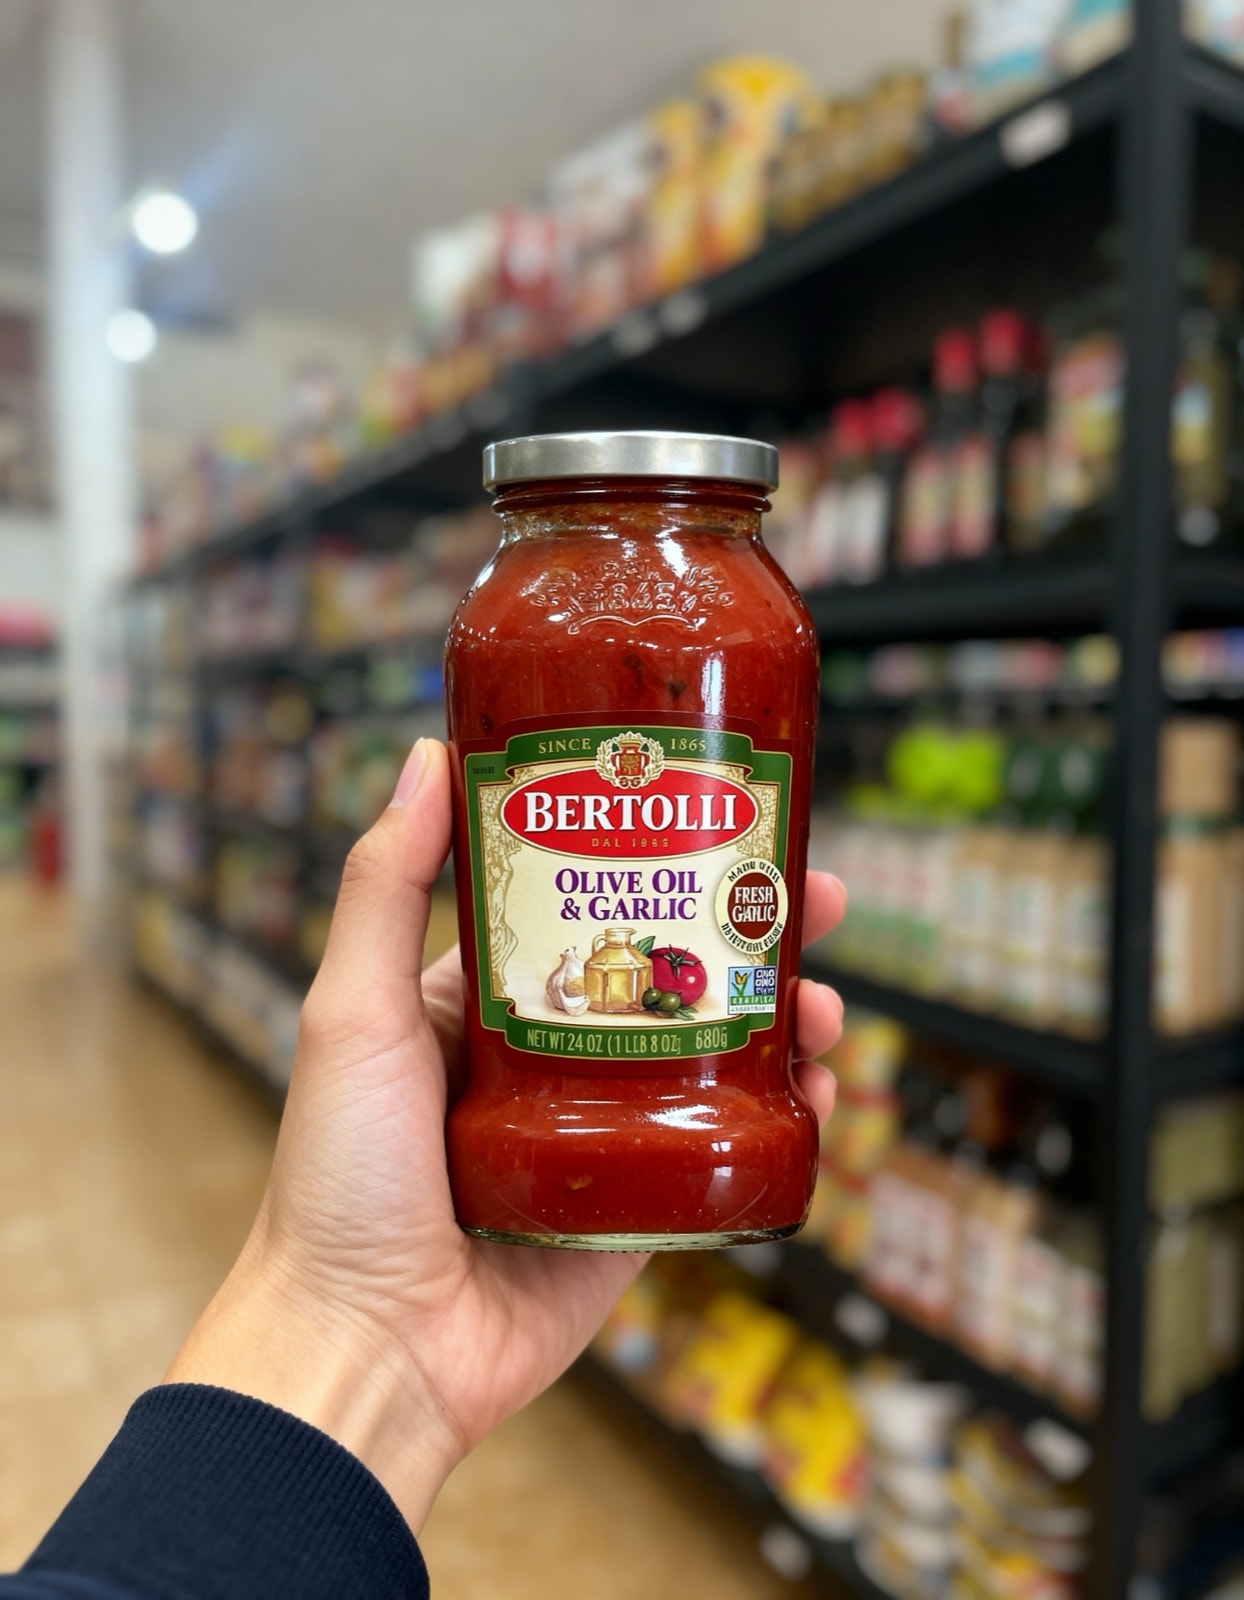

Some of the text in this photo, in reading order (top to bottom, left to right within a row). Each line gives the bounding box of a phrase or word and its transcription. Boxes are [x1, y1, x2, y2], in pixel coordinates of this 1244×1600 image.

[538, 737, 706, 754] SINCE 1865
[523, 791, 737, 833] BERTOLLI
[591, 837, 621, 848] DAL
[555, 868, 702, 894] OLIVE OIL
[734, 886, 774, 904] FRESH
[560, 896, 697, 921] & GARLIC
[526, 1029, 547, 1048] NET
[549, 1031, 565, 1051] WT
[567, 1032, 584, 1052] 24
[587, 1034, 603, 1053] OZ
[650, 1034, 658, 1053] 8
